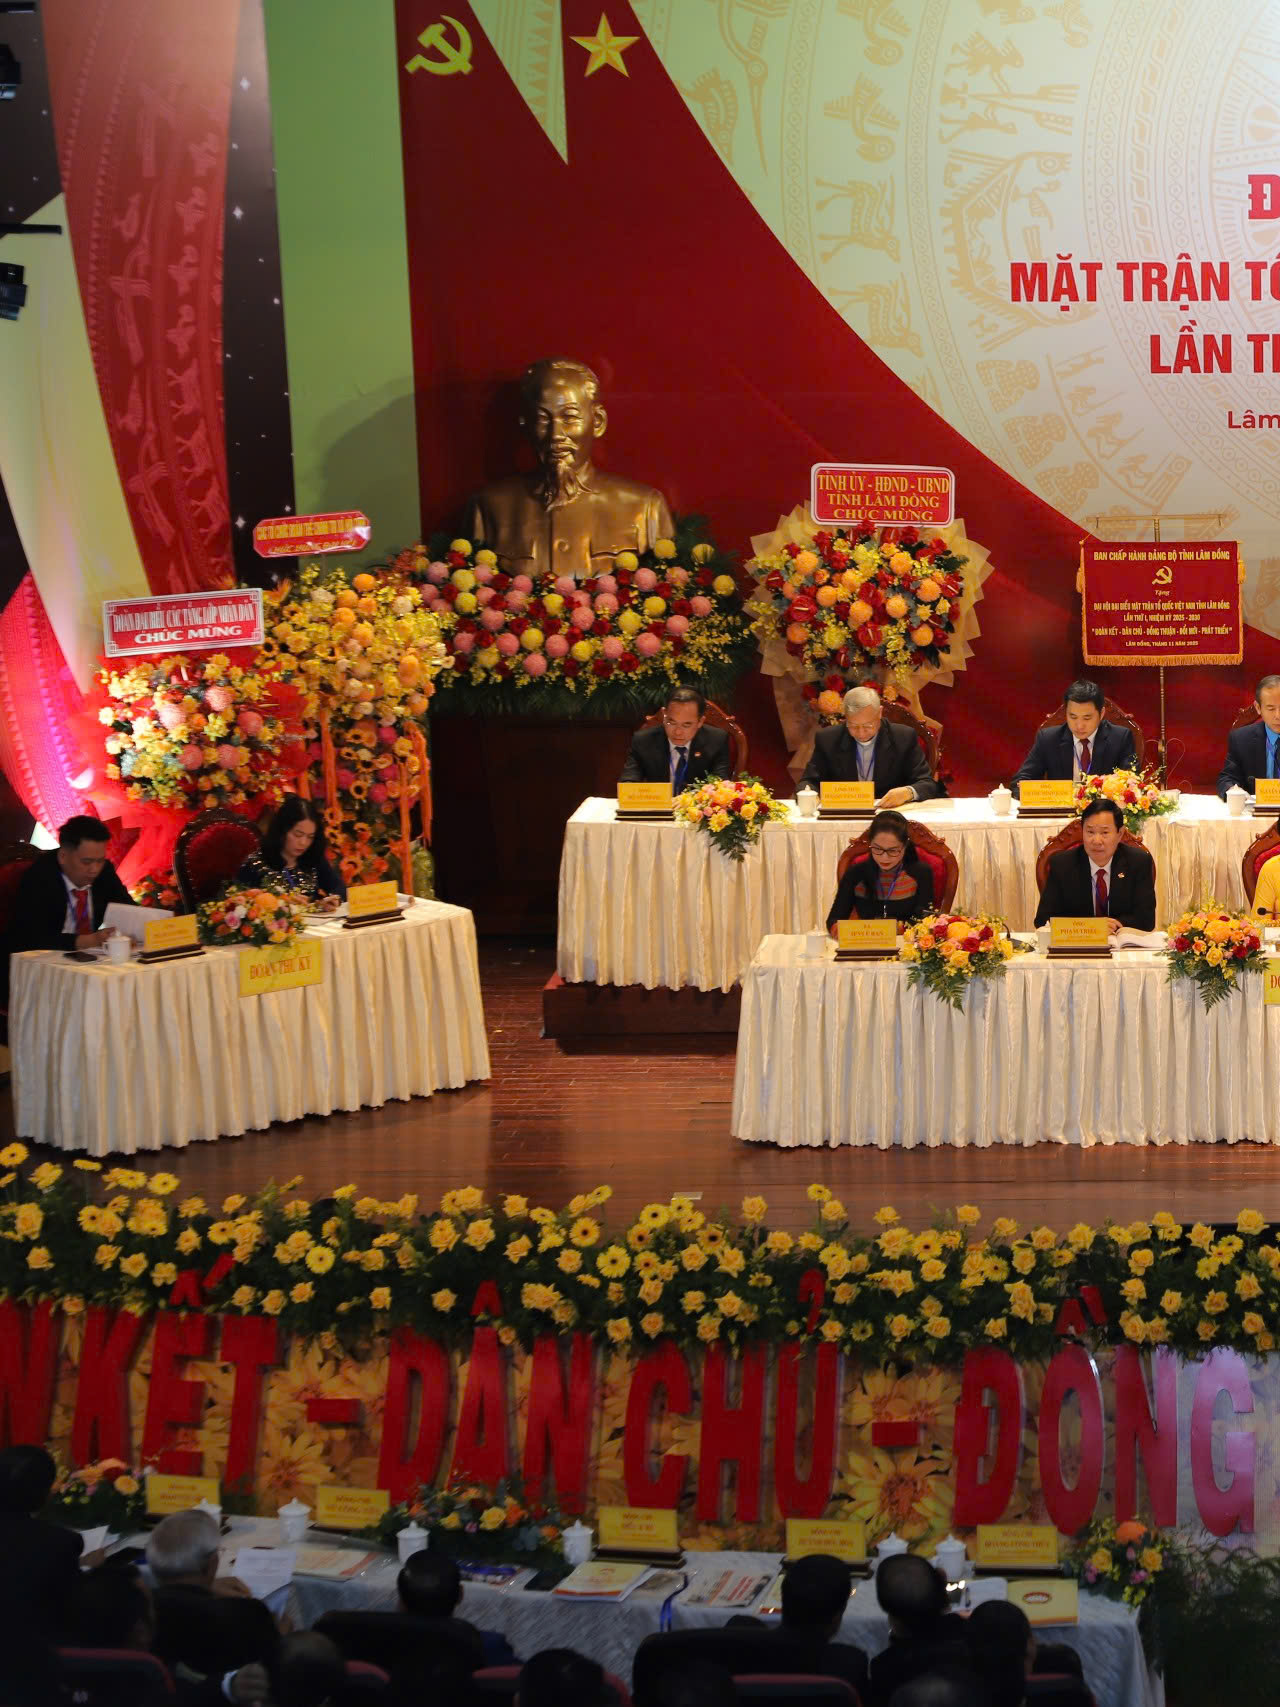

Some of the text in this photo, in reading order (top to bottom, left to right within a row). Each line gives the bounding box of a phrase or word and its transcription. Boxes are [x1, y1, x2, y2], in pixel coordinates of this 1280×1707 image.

[1010, 253, 1104, 312] MẶT
[1116, 252, 1230, 309] TRẬN
[1149, 320, 1233, 375] LẦN
[817, 470, 846, 491] TỈNH
[874, 476, 909, 493] HĐND
[917, 477, 950, 494] UBND
[827, 489, 940, 508] TỈNH LÂM ĐỒNG
[833, 506, 934, 521] CHÚC MỪNG
[1093, 547, 1231, 562] BAN CHẤP HÀNH ĐẢNG BỘ TỈNH LÂM ĐỒNG
[134, 625, 243, 644] CHÚC MỪNG
[70, 1252, 279, 1496] KẾT
[376, 1280, 595, 1514] DÂN
[623, 1268, 839, 1522] CHỦ
[952, 1284, 1257, 1538] ĐỒNG
